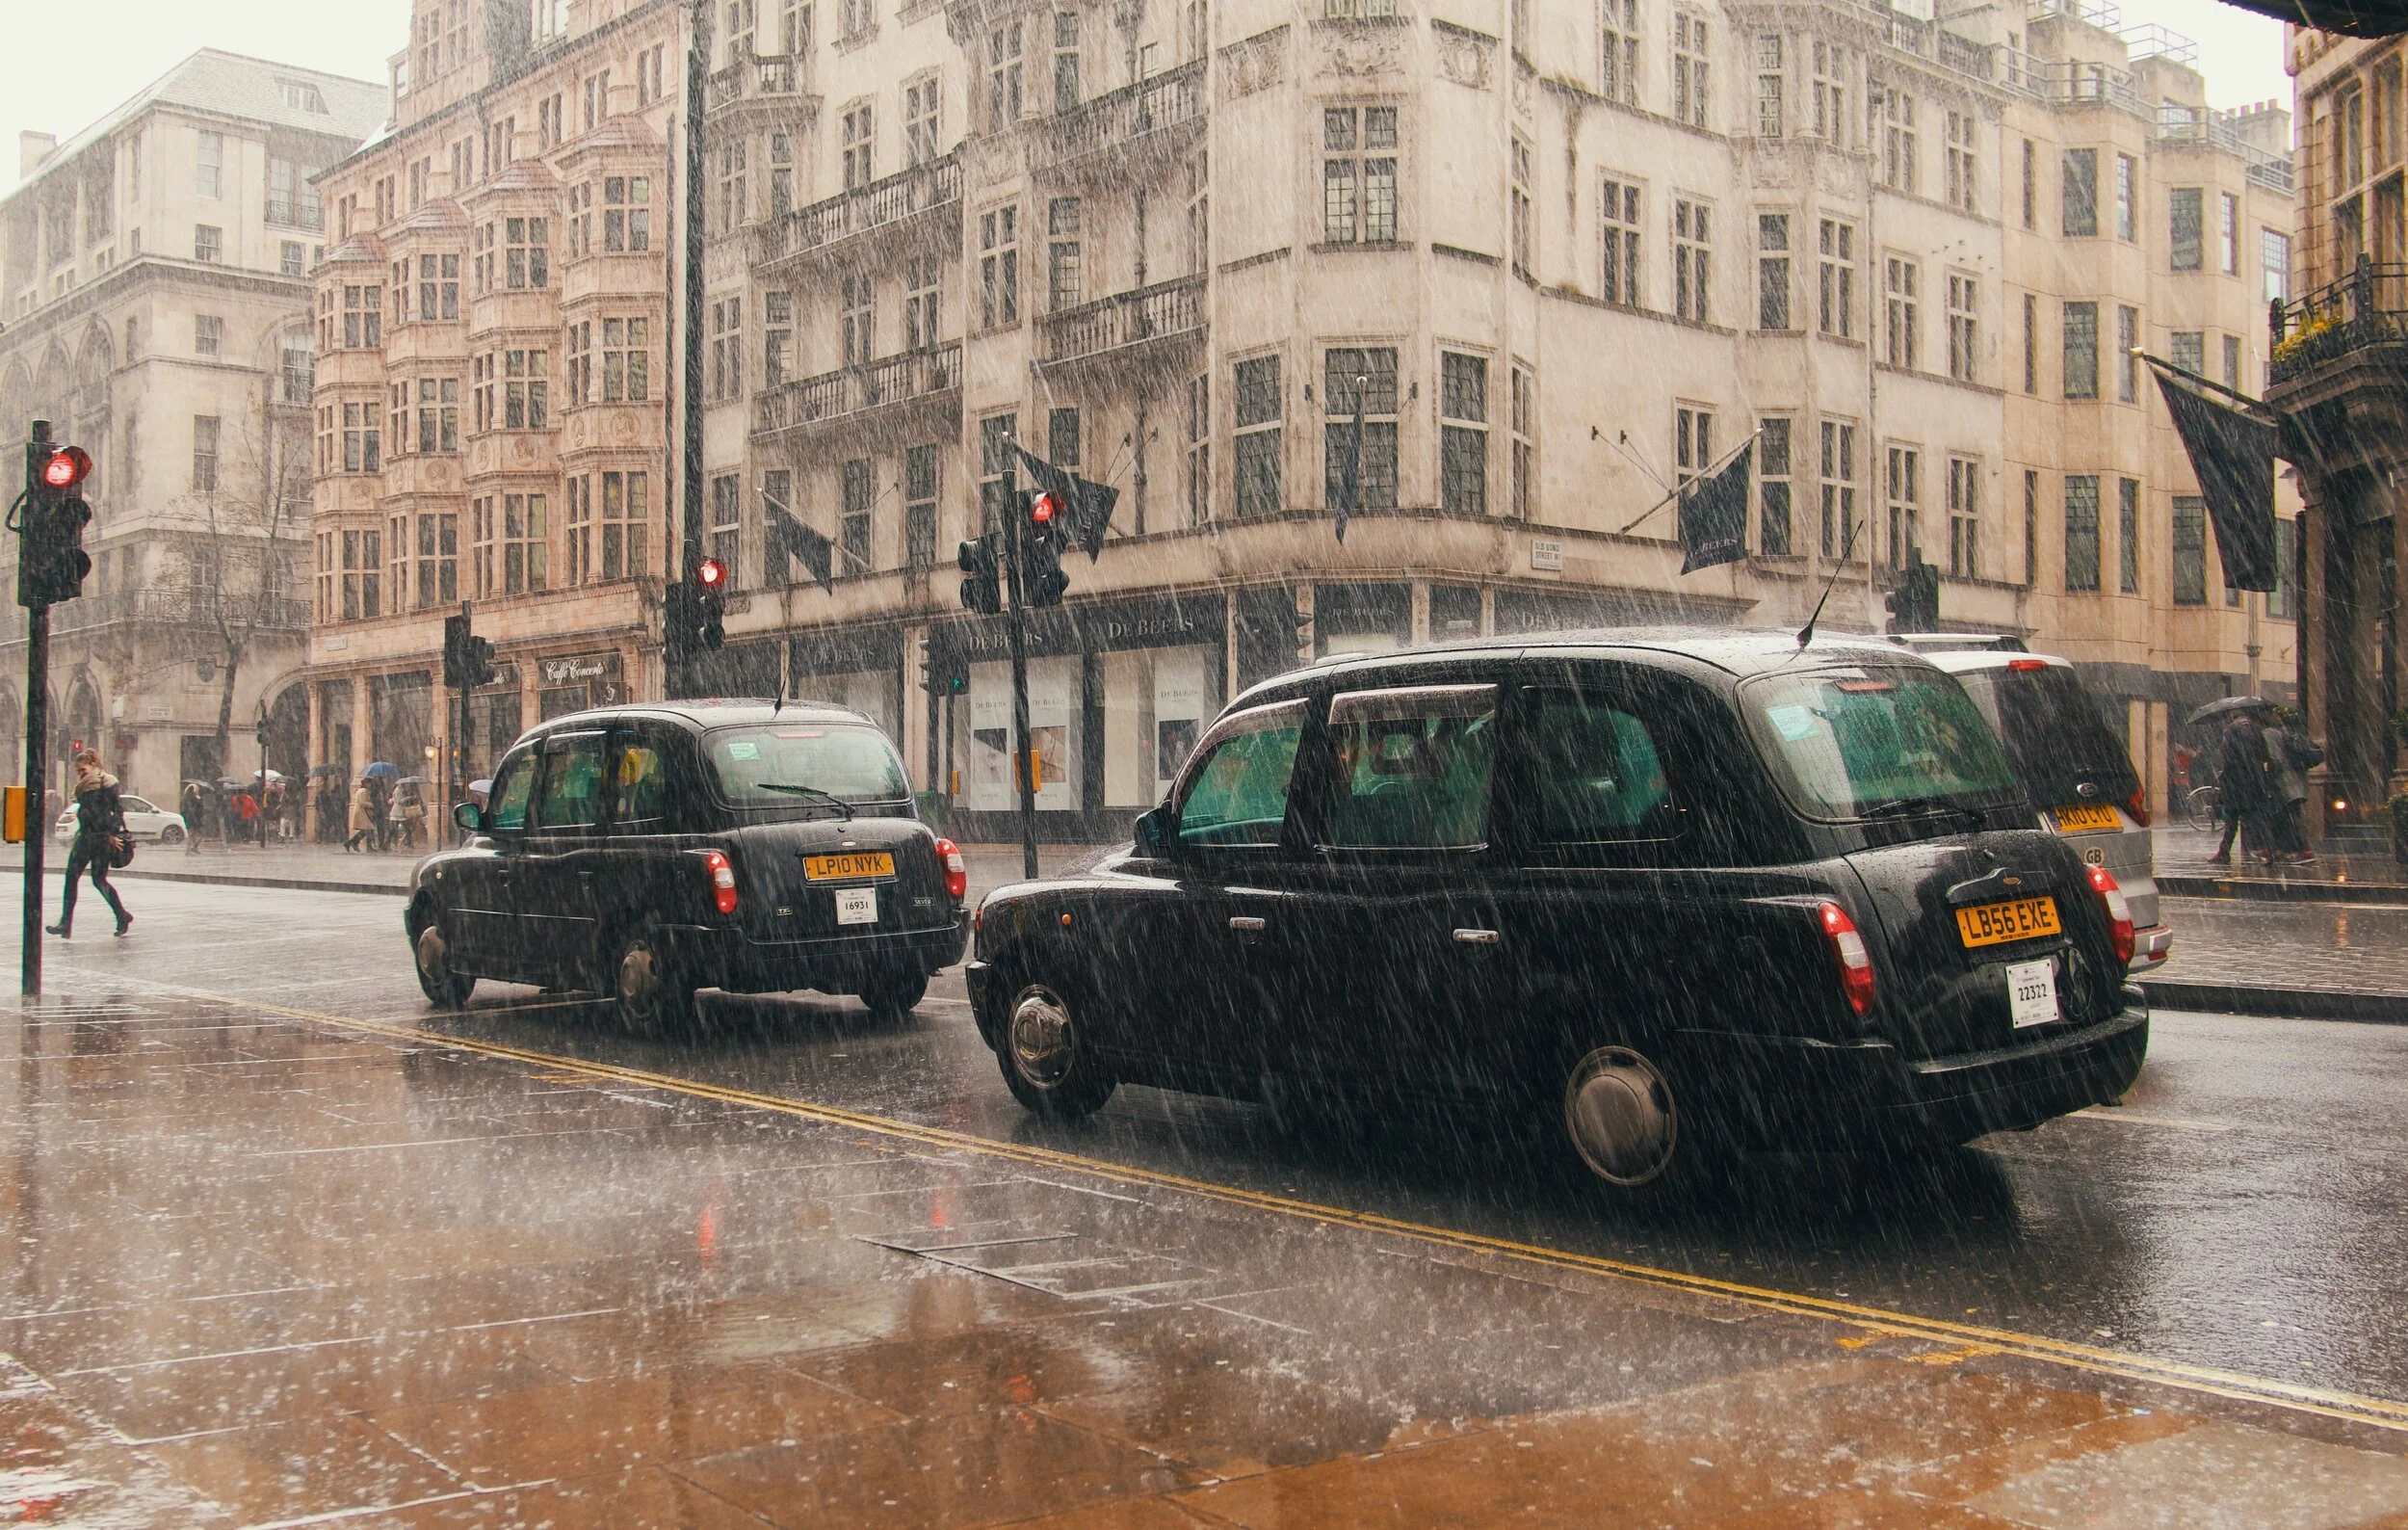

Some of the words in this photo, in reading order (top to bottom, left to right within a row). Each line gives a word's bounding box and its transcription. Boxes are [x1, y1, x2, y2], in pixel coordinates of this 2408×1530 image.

[1109, 621, 1133, 638] DE
[1138, 617, 1194, 636] BEERS
[969, 636, 989, 650] DE
[994, 633, 1043, 647] BERS
[568, 659, 604, 679] Concerto
[816, 857, 851, 876] LP10
[854, 855, 884, 874] NYK
[2085, 849, 2102, 864] GB
[845, 901, 869, 910] 16931
[1964, 906, 2016, 939] LB56
[2016, 901, 2052, 932] EXE
[2018, 983, 2047, 1001] 22322
